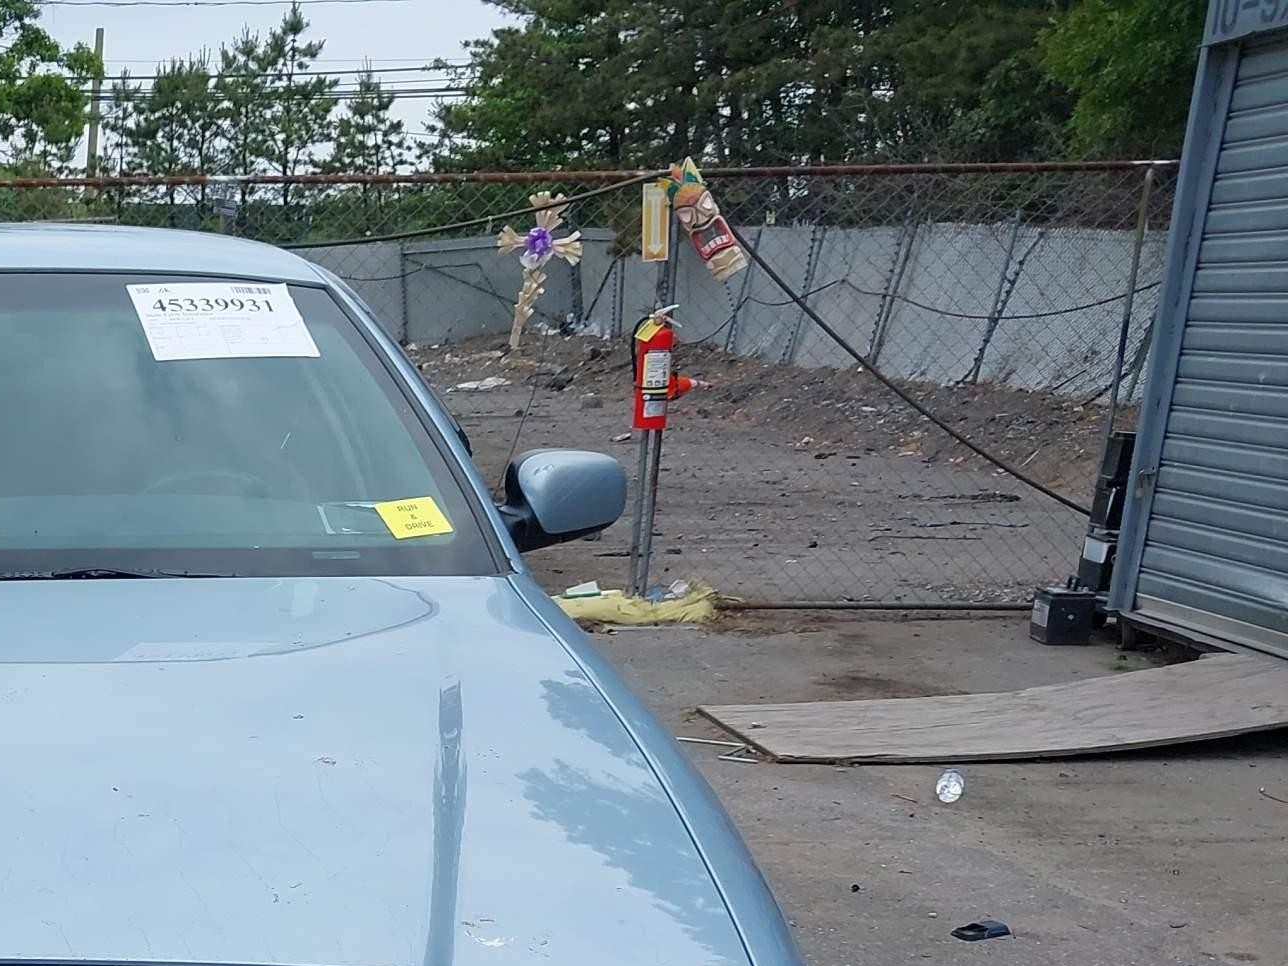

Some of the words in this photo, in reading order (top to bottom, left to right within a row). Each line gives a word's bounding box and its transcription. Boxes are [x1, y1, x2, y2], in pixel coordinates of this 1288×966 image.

[152, 298, 274, 312] 45339931
[396, 504, 418, 512] RUN
[405, 520, 435, 531] DRIVE
